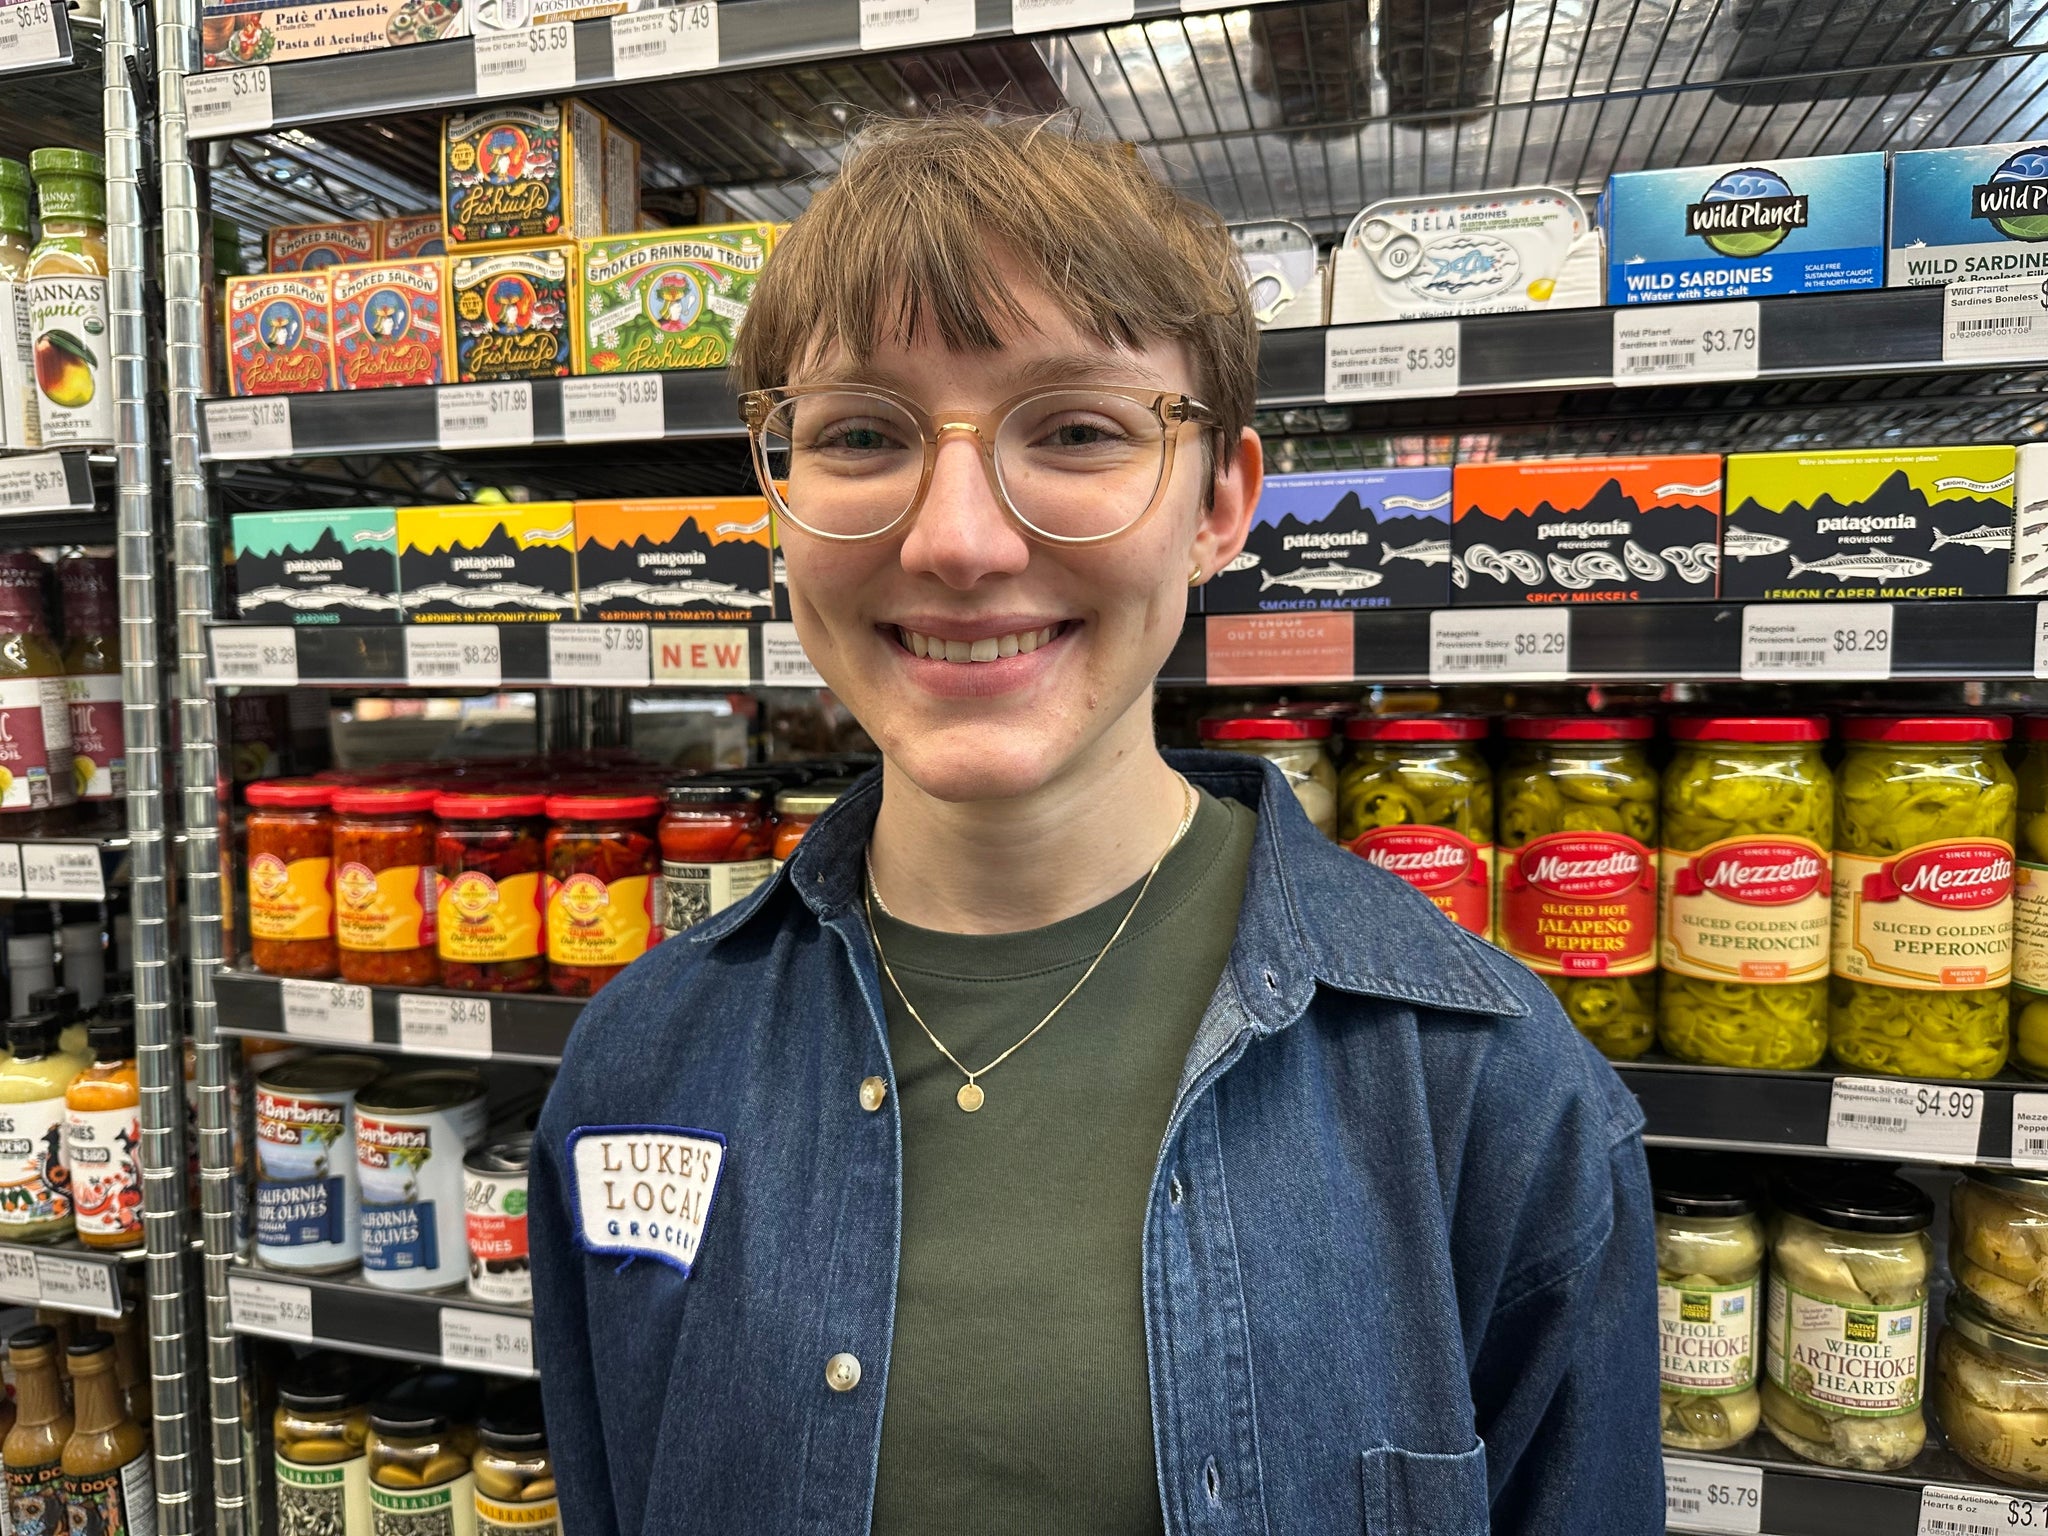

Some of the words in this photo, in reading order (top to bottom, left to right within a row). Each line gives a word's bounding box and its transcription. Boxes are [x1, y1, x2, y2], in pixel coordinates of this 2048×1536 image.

[17, 2, 48, 28] $6.49
[275, 9, 309, 25] Patè
[314, 5, 389, 21] d'Anchois
[534, 0, 588, 13] AGOSTINO
[669, 5, 710, 34] $7.49
[277, 38, 308, 51] Pasta
[313, 37, 326, 47] di
[329, 32, 385, 49] Acciughe
[530, 26, 568, 53] $5.59
[233, 71, 267, 96] $3.19
[461, 182, 549, 224] Fishwife
[1980, 187, 2028, 213] Wild
[1411, 215, 1457, 232] BELA
[1460, 210, 1508, 221] SARDINES
[1692, 203, 1738, 231] Wild
[1741, 197, 1801, 228] Planet
[280, 232, 321, 256] SMOKED
[325, 231, 366, 250] SALMON
[394, 224, 437, 248] SMOKED
[590, 252, 647, 282] SMOKED
[650, 244, 713, 261] RAINBOW
[718, 249, 761, 270] TROUT
[1804, 264, 1825, 272] SCALE
[1826, 263, 1841, 271] FREE
[1908, 259, 1958, 276] WILD
[1965, 253, 2048, 272] SARDINE
[1626, 274, 1674, 291] WILD
[1680, 266, 1773, 288] SARDINES
[1804, 271, 1844, 280] SUSTAINABLY
[1846, 269, 1873, 277] CAUGHT
[1804, 280, 1812, 288] IN
[1813, 279, 1825, 287] THE
[1826, 278, 1849, 286] NORTH
[1850, 276, 1874, 285] PACIFIC
[341, 275, 385, 299] SMOKED
[388, 272, 433, 292] SALMON
[1627, 291, 1637, 303] In
[1640, 289, 1673, 302] Water
[1676, 288, 1700, 300] with
[1703, 287, 1724, 298] Sea
[1726, 285, 1749, 296] Salt
[1951, 287, 1974, 296] Wild
[1976, 285, 2009, 294] Planet
[238, 285, 280, 309] SMOKED
[283, 284, 325, 304] SALMON
[1951, 297, 1993, 307] Sardines
[1995, 293, 2039, 303] Boneless
[1702, 328, 1756, 354] $3.79
[350, 342, 432, 382] Fishwife
[626, 334, 726, 372] Fishwife
[1407, 347, 1456, 372] $5.39
[246, 352, 324, 390] Fishwife
[491, 388, 527, 413] $17.99
[618, 380, 658, 406] $13.99
[252, 402, 286, 426] $17.99
[34, 471, 64, 491] $6.79
[1990, 477, 2013, 490] SAVORY
[1537, 520, 1632, 541] patagonia
[1816, 513, 1916, 535] patagonia
[1283, 529, 1369, 551] patagonia
[1557, 540, 1611, 550] PROVISIONS
[1838, 534, 1894, 545] PROVISIONS
[453, 555, 516, 572] patagonia
[637, 550, 707, 569] patagonia
[1301, 550, 1350, 560] PROVISIONS
[285, 556, 344, 575] patagonia
[653, 568, 692, 577] PROVISIONS
[1526, 592, 1569, 603] SPICY
[1571, 591, 1639, 602] MUSSELS
[1764, 588, 1822, 599] LEMON
[1826, 588, 1875, 598] CAPER
[1878, 587, 1964, 597] MACKEREL
[1258, 599, 1317, 610] SMOKED
[1319, 597, 1392, 609] MACKEREL
[294, 613, 340, 624] SARDINES
[413, 612, 462, 623] SARDINES
[464, 612, 475, 623] IN
[477, 612, 526, 622] COCONUT
[528, 612, 562, 622] CURRY
[599, 611, 651, 621] SARDINES
[654, 611, 666, 621] IN
[668, 611, 715, 620] TOMATO
[717, 610, 753, 620] SAUCE
[605, 627, 645, 651] $7.99
[1436, 630, 1480, 640] Patagonia
[1749, 625, 1796, 634] Patagonia
[1514, 632, 1566, 656] $8.29
[1749, 636, 1795, 645] Provisions
[1797, 636, 1827, 644] Lemon
[1833, 629, 1888, 654] $8.29
[263, 647, 295, 666] $8.29
[464, 645, 499, 665] $8.29
[662, 643, 744, 670] NEW
[1367, 844, 1466, 870] Mezzetta
[1527, 850, 1640, 883] Mezzetta
[1703, 855, 1820, 888] Mezzetta
[1901, 857, 2012, 893] Mezzetta
[1941, 890, 1978, 901] FAMILY
[1980, 888, 1994, 897] CO.
[1542, 903, 1594, 917] SLICED
[1598, 903, 1629, 916] HOT
[1537, 917, 1632, 935] JALAPEÑO
[1873, 920, 1931, 936] SLICED
[1936, 924, 1996, 937] GOLDEN
[1545, 935, 1625, 951] PEPPERS
[1698, 932, 1820, 951] PEPERONCINI
[1572, 958, 1599, 968] HOT
[330, 986, 365, 1010] $8.49
[450, 1000, 487, 1024] $8.49
[1834, 1081, 1876, 1093] Mezzetta
[1878, 1086, 1908, 1096] Sliced
[265, 1098, 341, 1123] Barbara
[1915, 1088, 1975, 1119] $4.99
[601, 1143, 712, 1183] LUKE'S
[257, 1184, 328, 1204] CALIFORNIA
[604, 1180, 702, 1226] LOCAL
[279, 1201, 327, 1221] OLIVES
[470, 1238, 513, 1252] OLIVES
[5, 1254, 34, 1278] $9.49
[77, 1265, 107, 1292] $9.49
[279, 1302, 311, 1321] $5.29
[1662, 1319, 1727, 1338] WHOLE
[1847, 1322, 1876, 1331] NATIVE
[1847, 1329, 1876, 1338] FOREST
[495, 1333, 530, 1355] $3.49
[1825, 1337, 1892, 1359] WHOLE
[1793, 1343, 1916, 1380] ARTICHOKE
[1817, 1371, 1896, 1396] HEARTS
[81, 1476, 118, 1494] DOG
[1707, 1483, 1758, 1508] $5.79
[1923, 1500, 1955, 1510] Hearts
[1960, 1495, 1999, 1506] Artichoke
